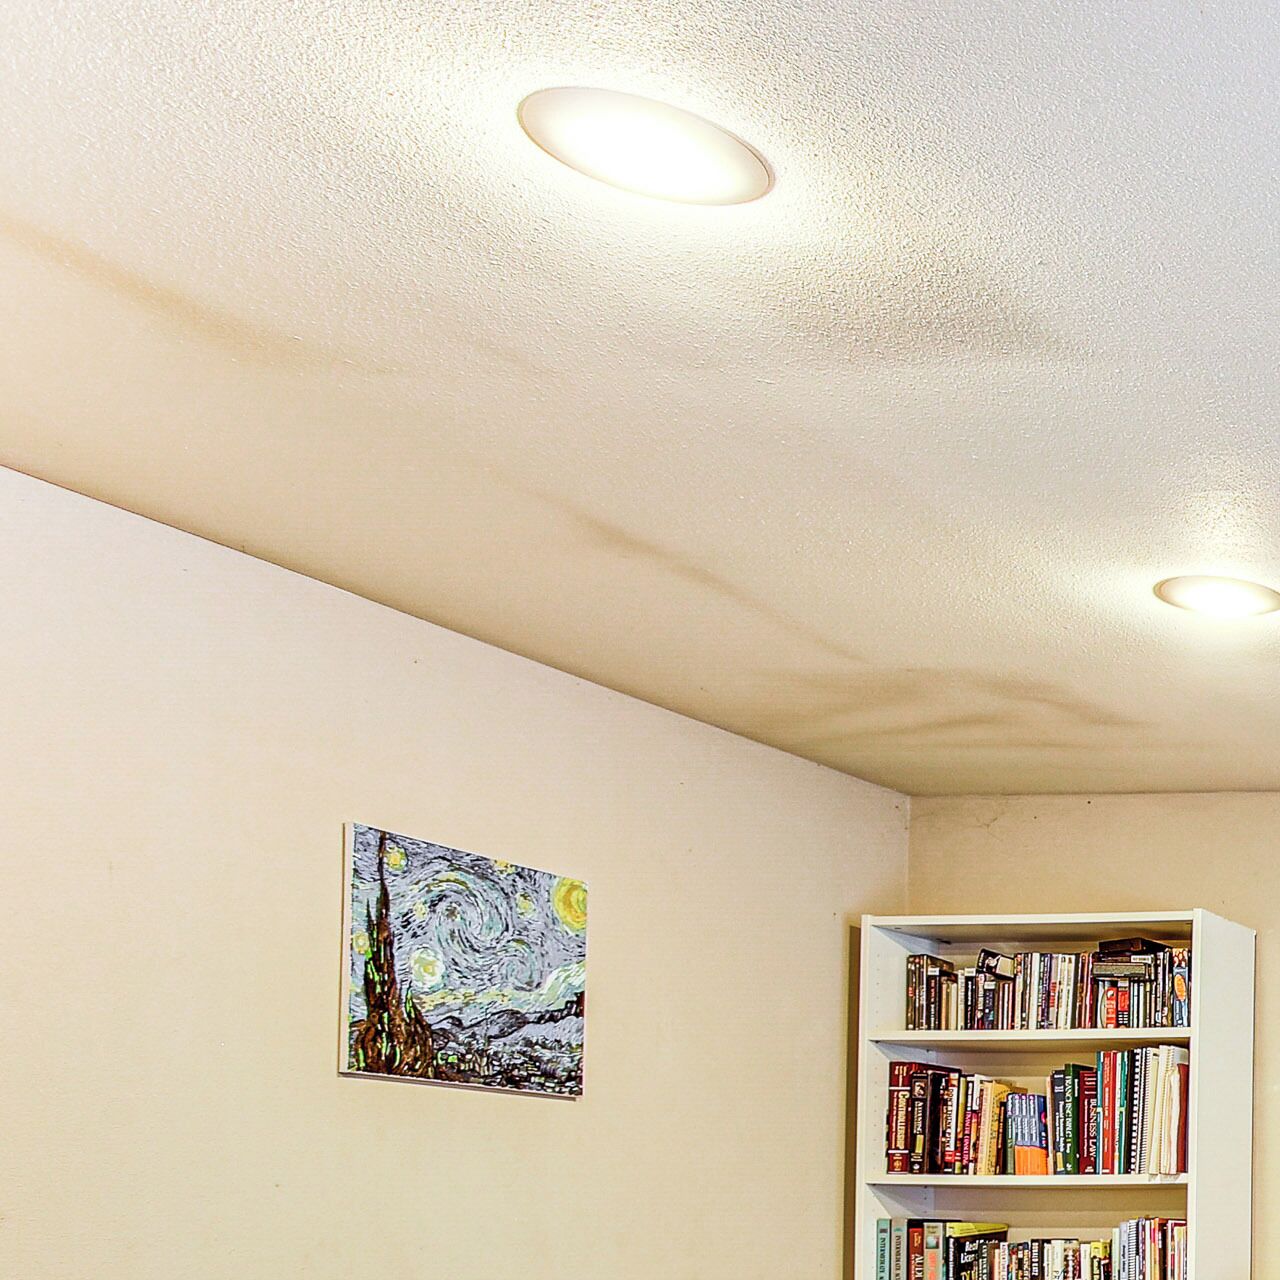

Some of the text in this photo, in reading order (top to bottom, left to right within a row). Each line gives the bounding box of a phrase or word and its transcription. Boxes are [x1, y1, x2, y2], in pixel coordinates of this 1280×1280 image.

[896, 1091, 910, 1150] CONTROLLERSHIP
[1089, 1098, 1097, 1157] BUSINESS LAW
